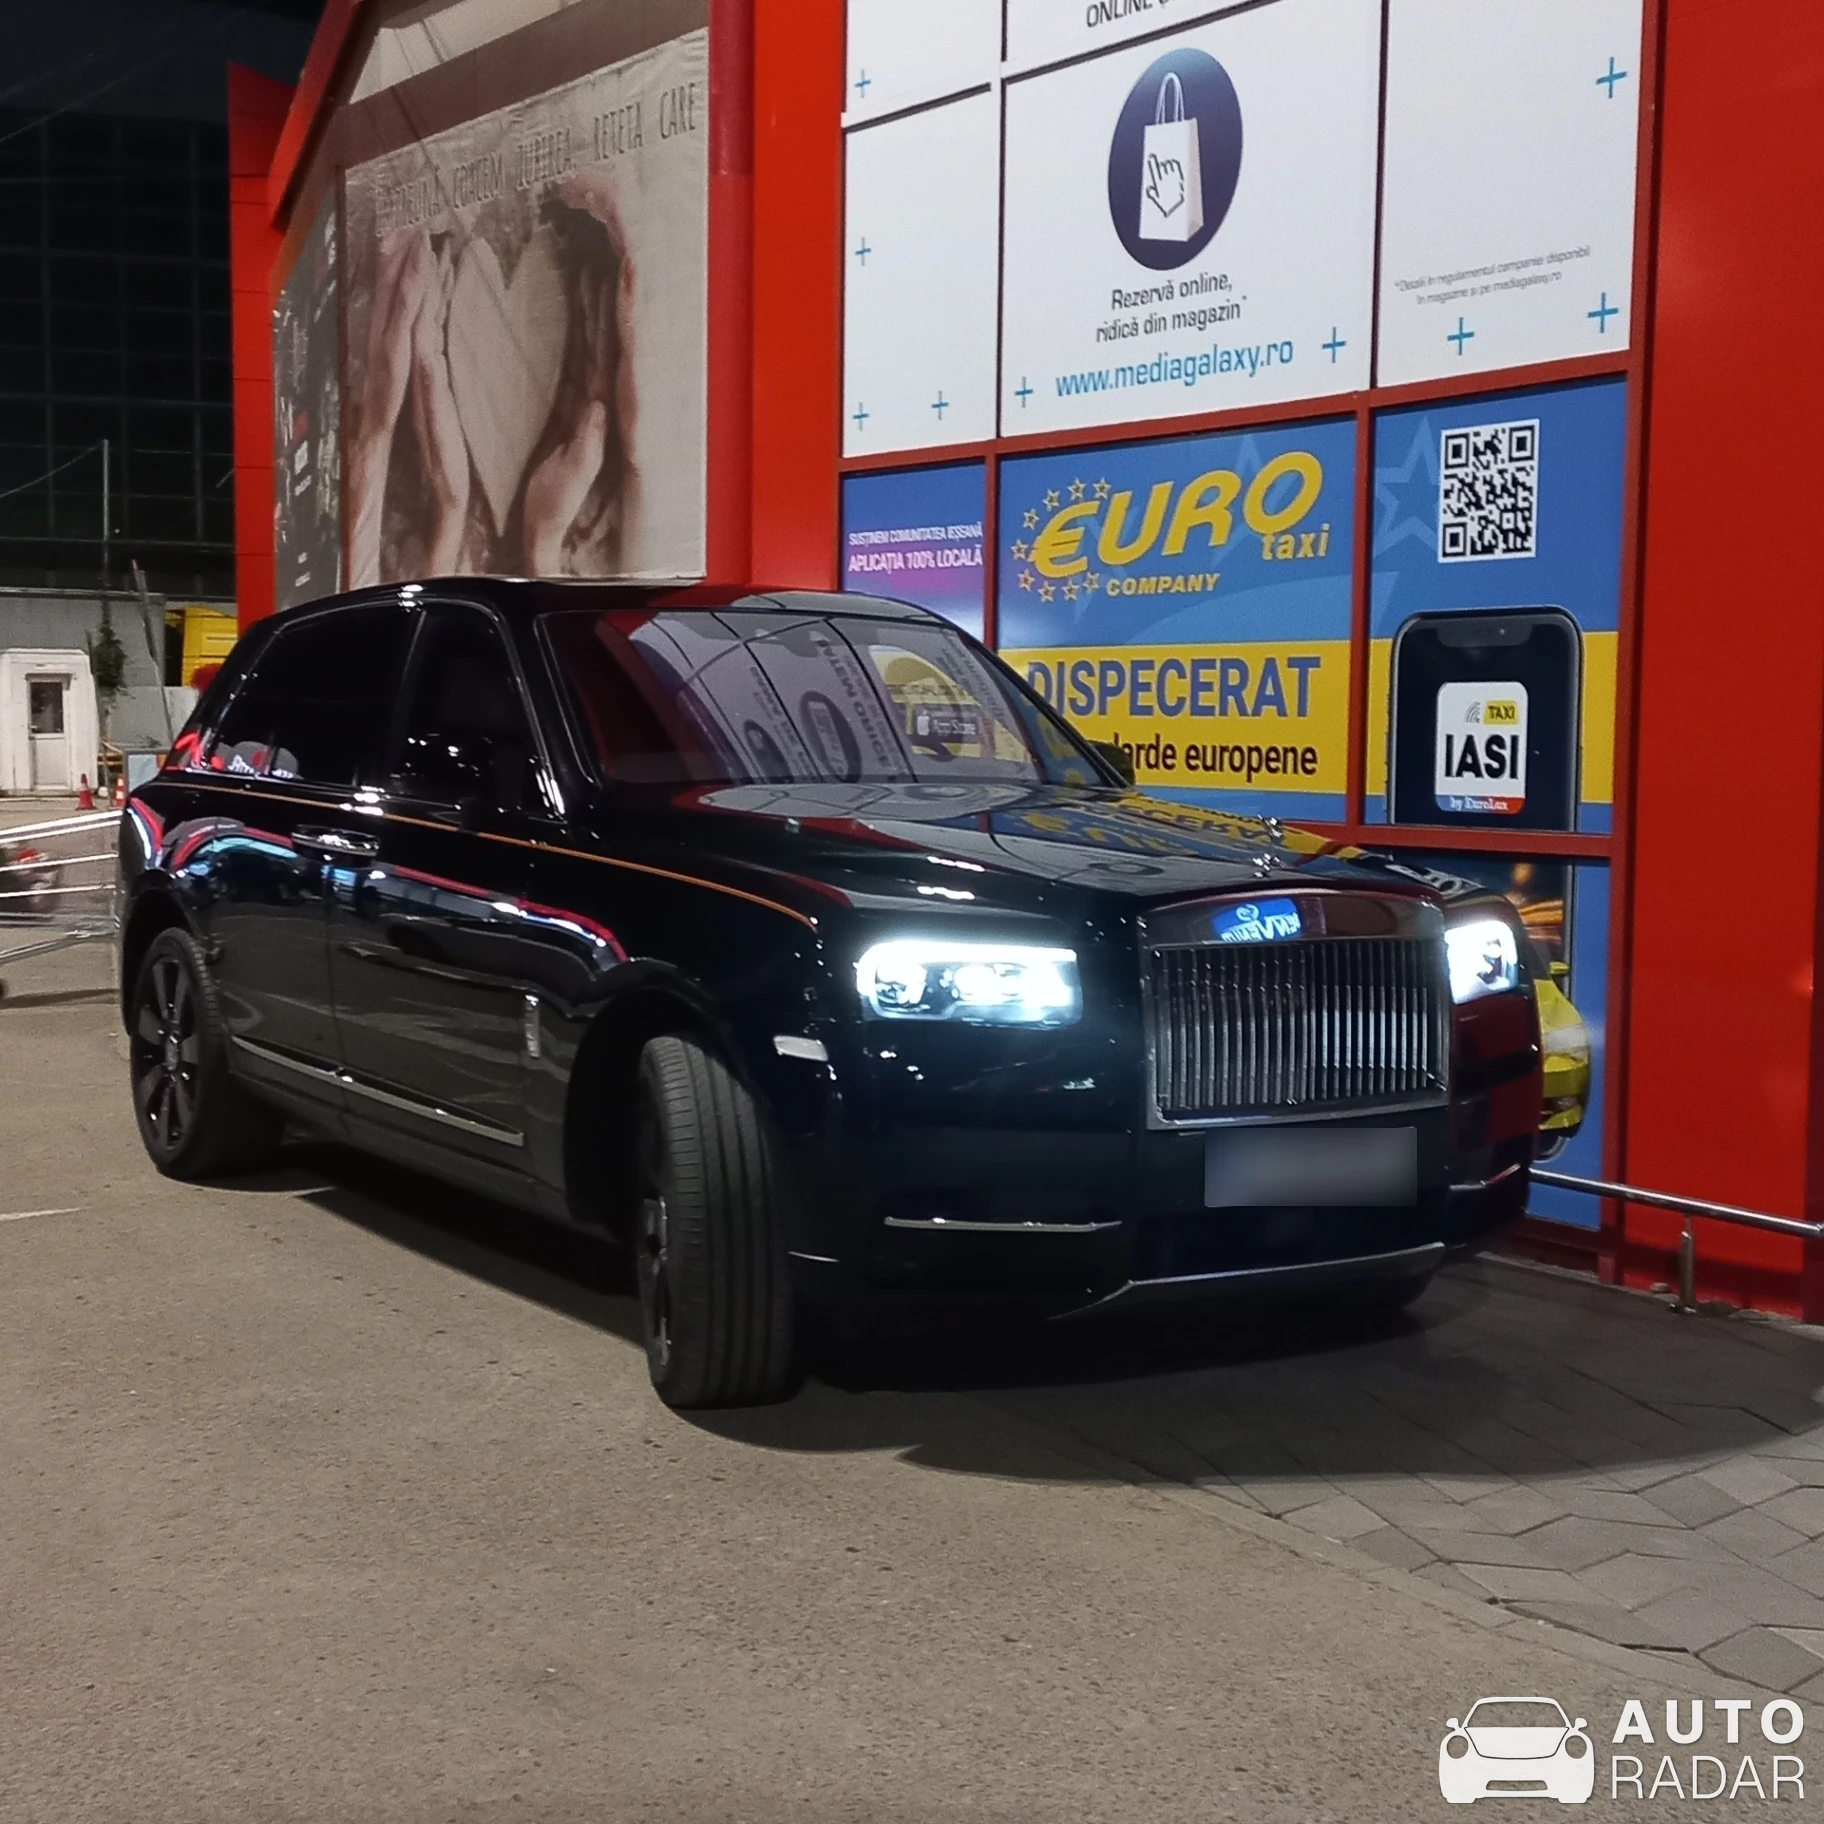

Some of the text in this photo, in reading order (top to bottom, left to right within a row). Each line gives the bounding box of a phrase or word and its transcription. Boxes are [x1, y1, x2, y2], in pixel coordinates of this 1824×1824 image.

[660, 82, 697, 139] CARE
[1179, 273, 1233, 298] online,
[1144, 313, 1168, 335] din
[1056, 340, 1294, 397] www.mediagalaxy.ro
[905, 550, 936, 569] 100%
[1261, 523, 1331, 560] taxi
[1106, 573, 1221, 596] COMPANY
[1027, 656, 1322, 718] DISPECERAT
[1487, 705, 1515, 719] TAXI
[1185, 742, 1318, 783] europene
[1444, 734, 1519, 780] IASI
